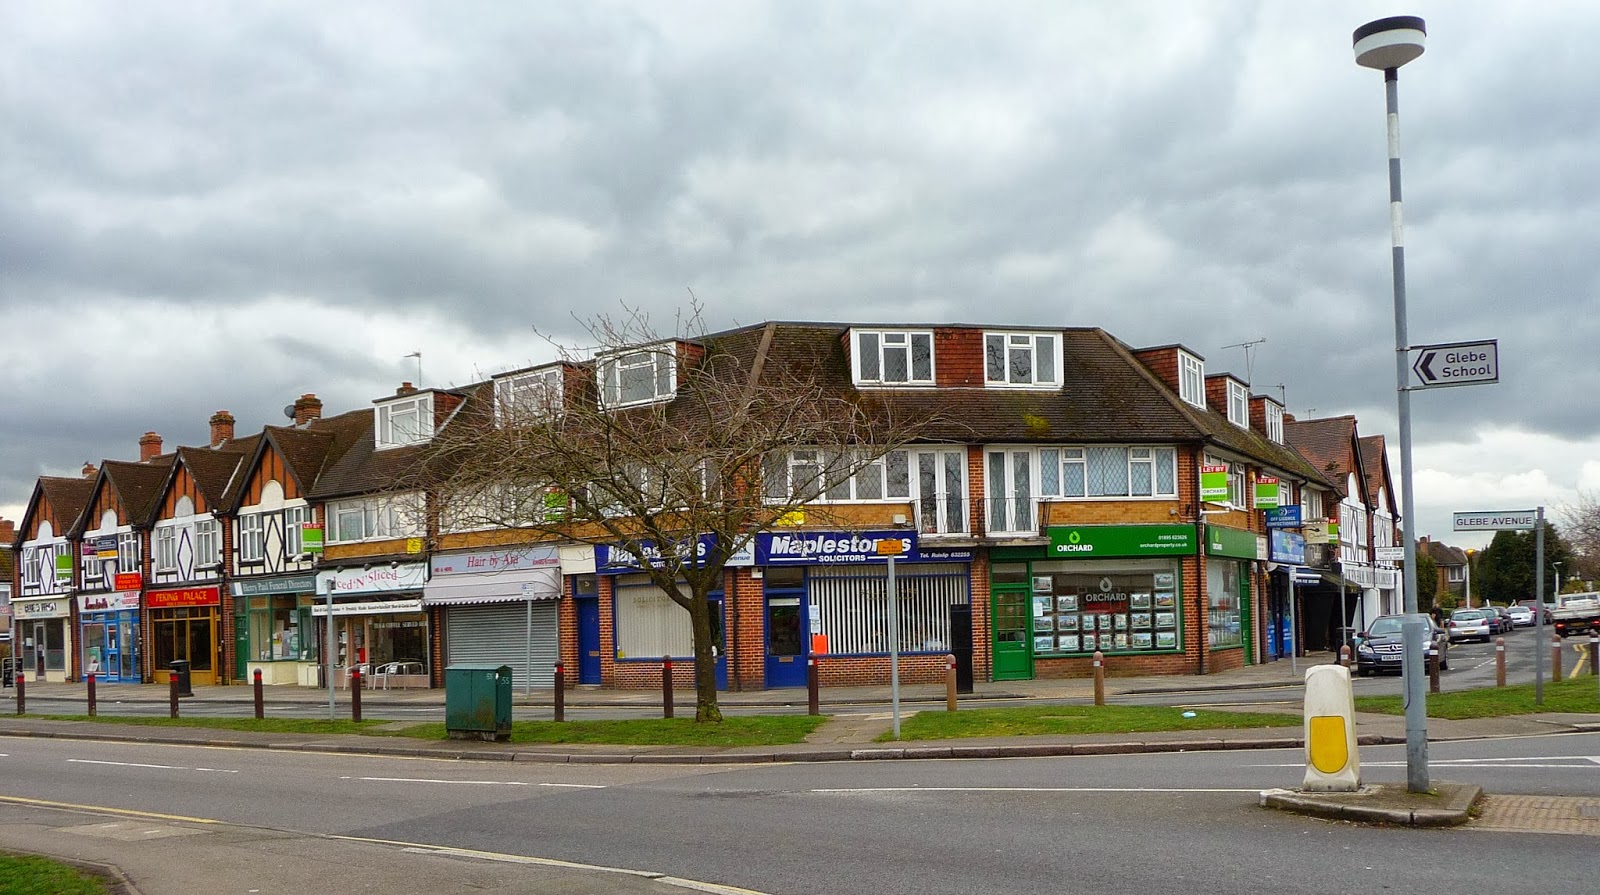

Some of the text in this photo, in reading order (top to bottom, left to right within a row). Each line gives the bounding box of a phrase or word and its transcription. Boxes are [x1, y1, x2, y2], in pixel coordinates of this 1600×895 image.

[1445, 352, 1487, 364] Glebe
[1442, 364, 1491, 377] School
[1456, 516, 1532, 527] GLEBE AVENUE
[770, 535, 912, 558] Maplestos
[1056, 544, 1093, 552] ORCHARD
[467, 556, 486, 568] Hair
[489, 555, 498, 568] by
[818, 554, 866, 563] SOLICITORS
[368, 570, 397, 583] Sliced
[242, 580, 312, 593] Henry Paul Funeral Directors
[155, 591, 207, 602] PEKING PALACE
[1085, 592, 1127, 602] ORCHARD
